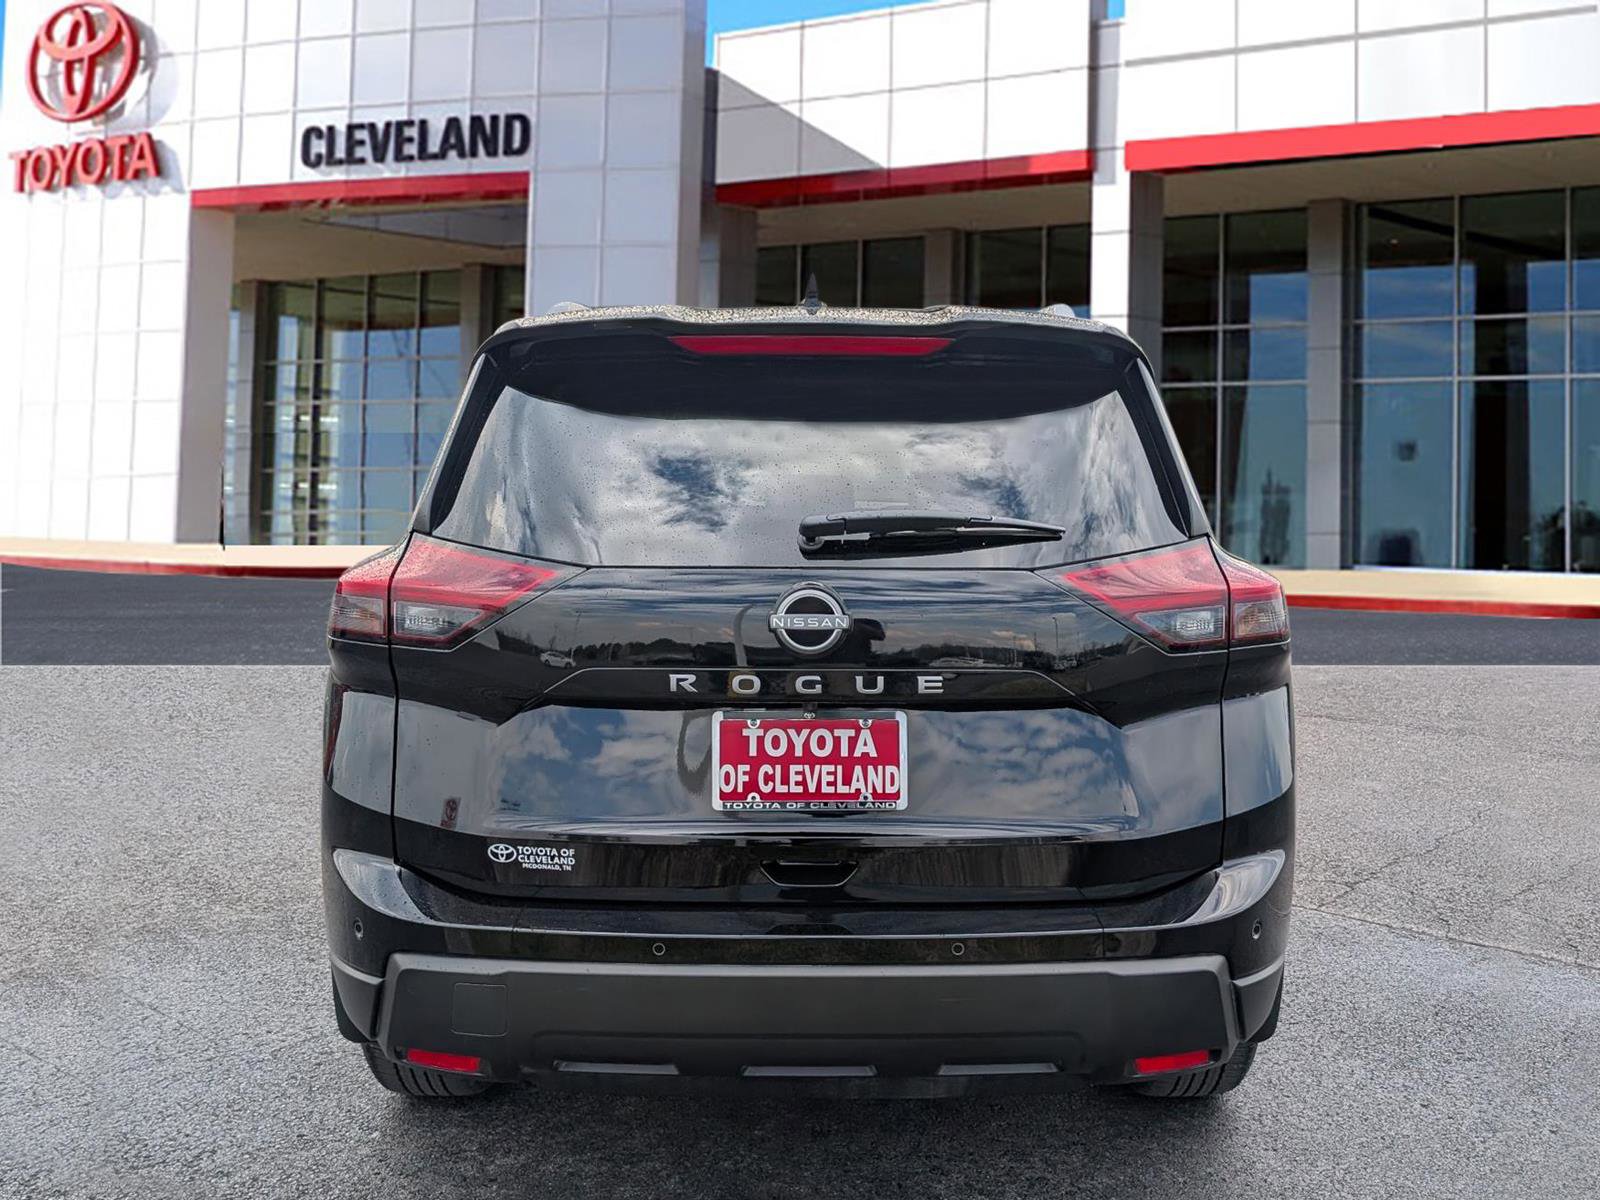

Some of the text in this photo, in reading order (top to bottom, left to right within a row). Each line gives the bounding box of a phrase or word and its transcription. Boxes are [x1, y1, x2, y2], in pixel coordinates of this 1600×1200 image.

[300, 112, 533, 169] CLEVELAND
[9, 131, 160, 193] TOYOTA
[772, 616, 848, 628] NISSAN
[668, 673, 945, 694] ROGUE
[742, 728, 878, 758] TOYOTA
[719, 764, 900, 795] OF CLEVELAND
[724, 801, 896, 810] TOYOTA OF CLEVELAND
[517, 846, 575, 857] TOYOTA OF
[517, 855, 575, 865] CLEVELAND
